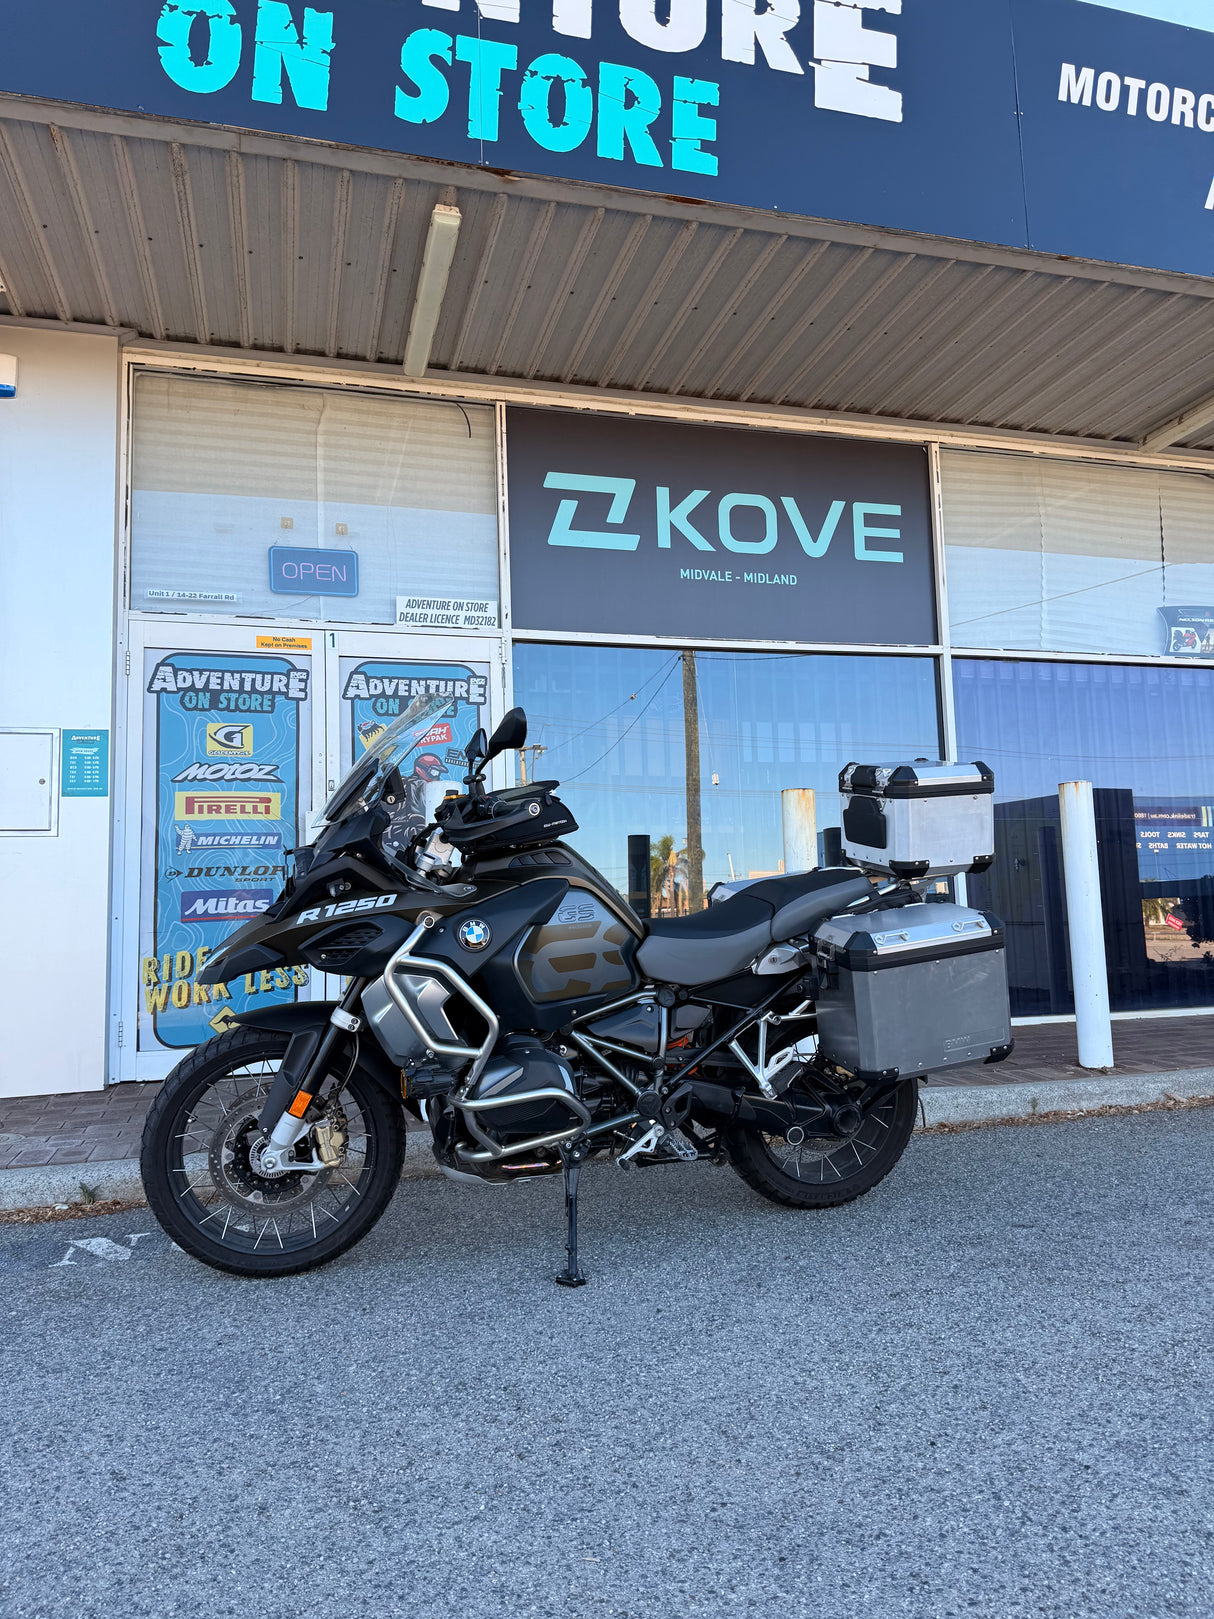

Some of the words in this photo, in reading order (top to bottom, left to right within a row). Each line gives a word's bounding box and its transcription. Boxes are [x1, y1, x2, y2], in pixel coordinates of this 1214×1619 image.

[156, 0, 336, 111] ON
[395, 28, 719, 176] STORE
[1058, 62, 1214, 132] MOTORC
[656, 486, 904, 563] KOVE
[282, 562, 347, 582] OPEN
[680, 568, 732, 582] MIDVALE
[744, 572, 798, 585] MIDLAND
[405, 599, 452, 611] ADVENTURE
[452, 600, 464, 611] ON
[465, 602, 489, 613] STORE
[398, 612, 429, 623] DEALER
[430, 613, 460, 625] LICENCE
[463, 615, 496, 626] MD32182
[329, 632, 335, 648] 1
[150, 665, 307, 699] ADVENTURE
[345, 674, 486, 703] ADVENTURE
[183, 691, 210, 709] ON
[218, 693, 272, 711] STORE
[375, 698, 400, 714] ON
[171, 762, 285, 783] MOTOZ
[185, 796, 272, 815] PIRELLI
[197, 835, 279, 846] MICHELIN
[184, 897, 270, 916] Mitas
[296, 907, 321, 925] R
[324, 893, 397, 918] 1250
[558, 903, 595, 923] GS
[463, 921, 486, 932] BMW
